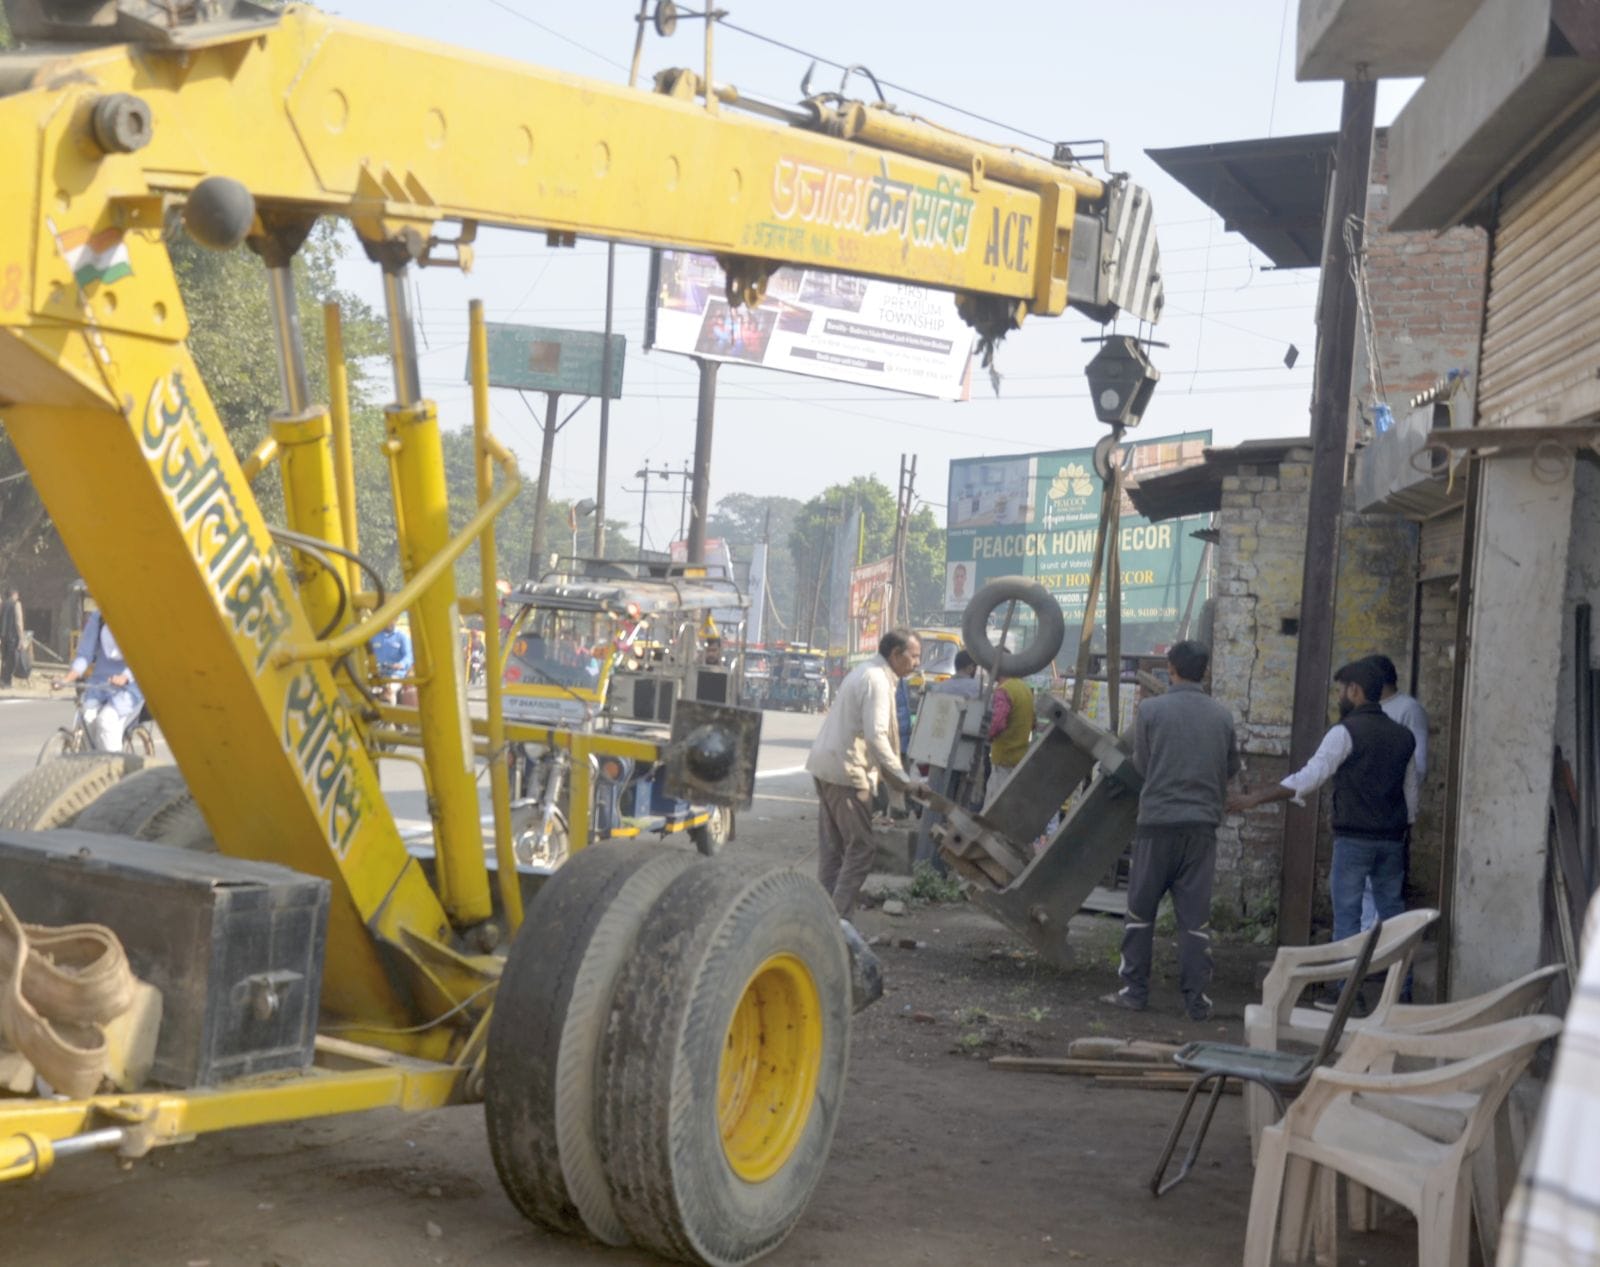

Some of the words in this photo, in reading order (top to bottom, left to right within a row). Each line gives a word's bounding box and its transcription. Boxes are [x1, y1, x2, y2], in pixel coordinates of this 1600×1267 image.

[983, 206, 1032, 272] ACE
[897, 284, 929, 300] FIRST
[883, 296, 942, 316] PREMIUM
[879, 309, 945, 331] TOWNSHIP
[141, 367, 258, 597] उजाला
[971, 533, 1047, 559] PEACOCK
